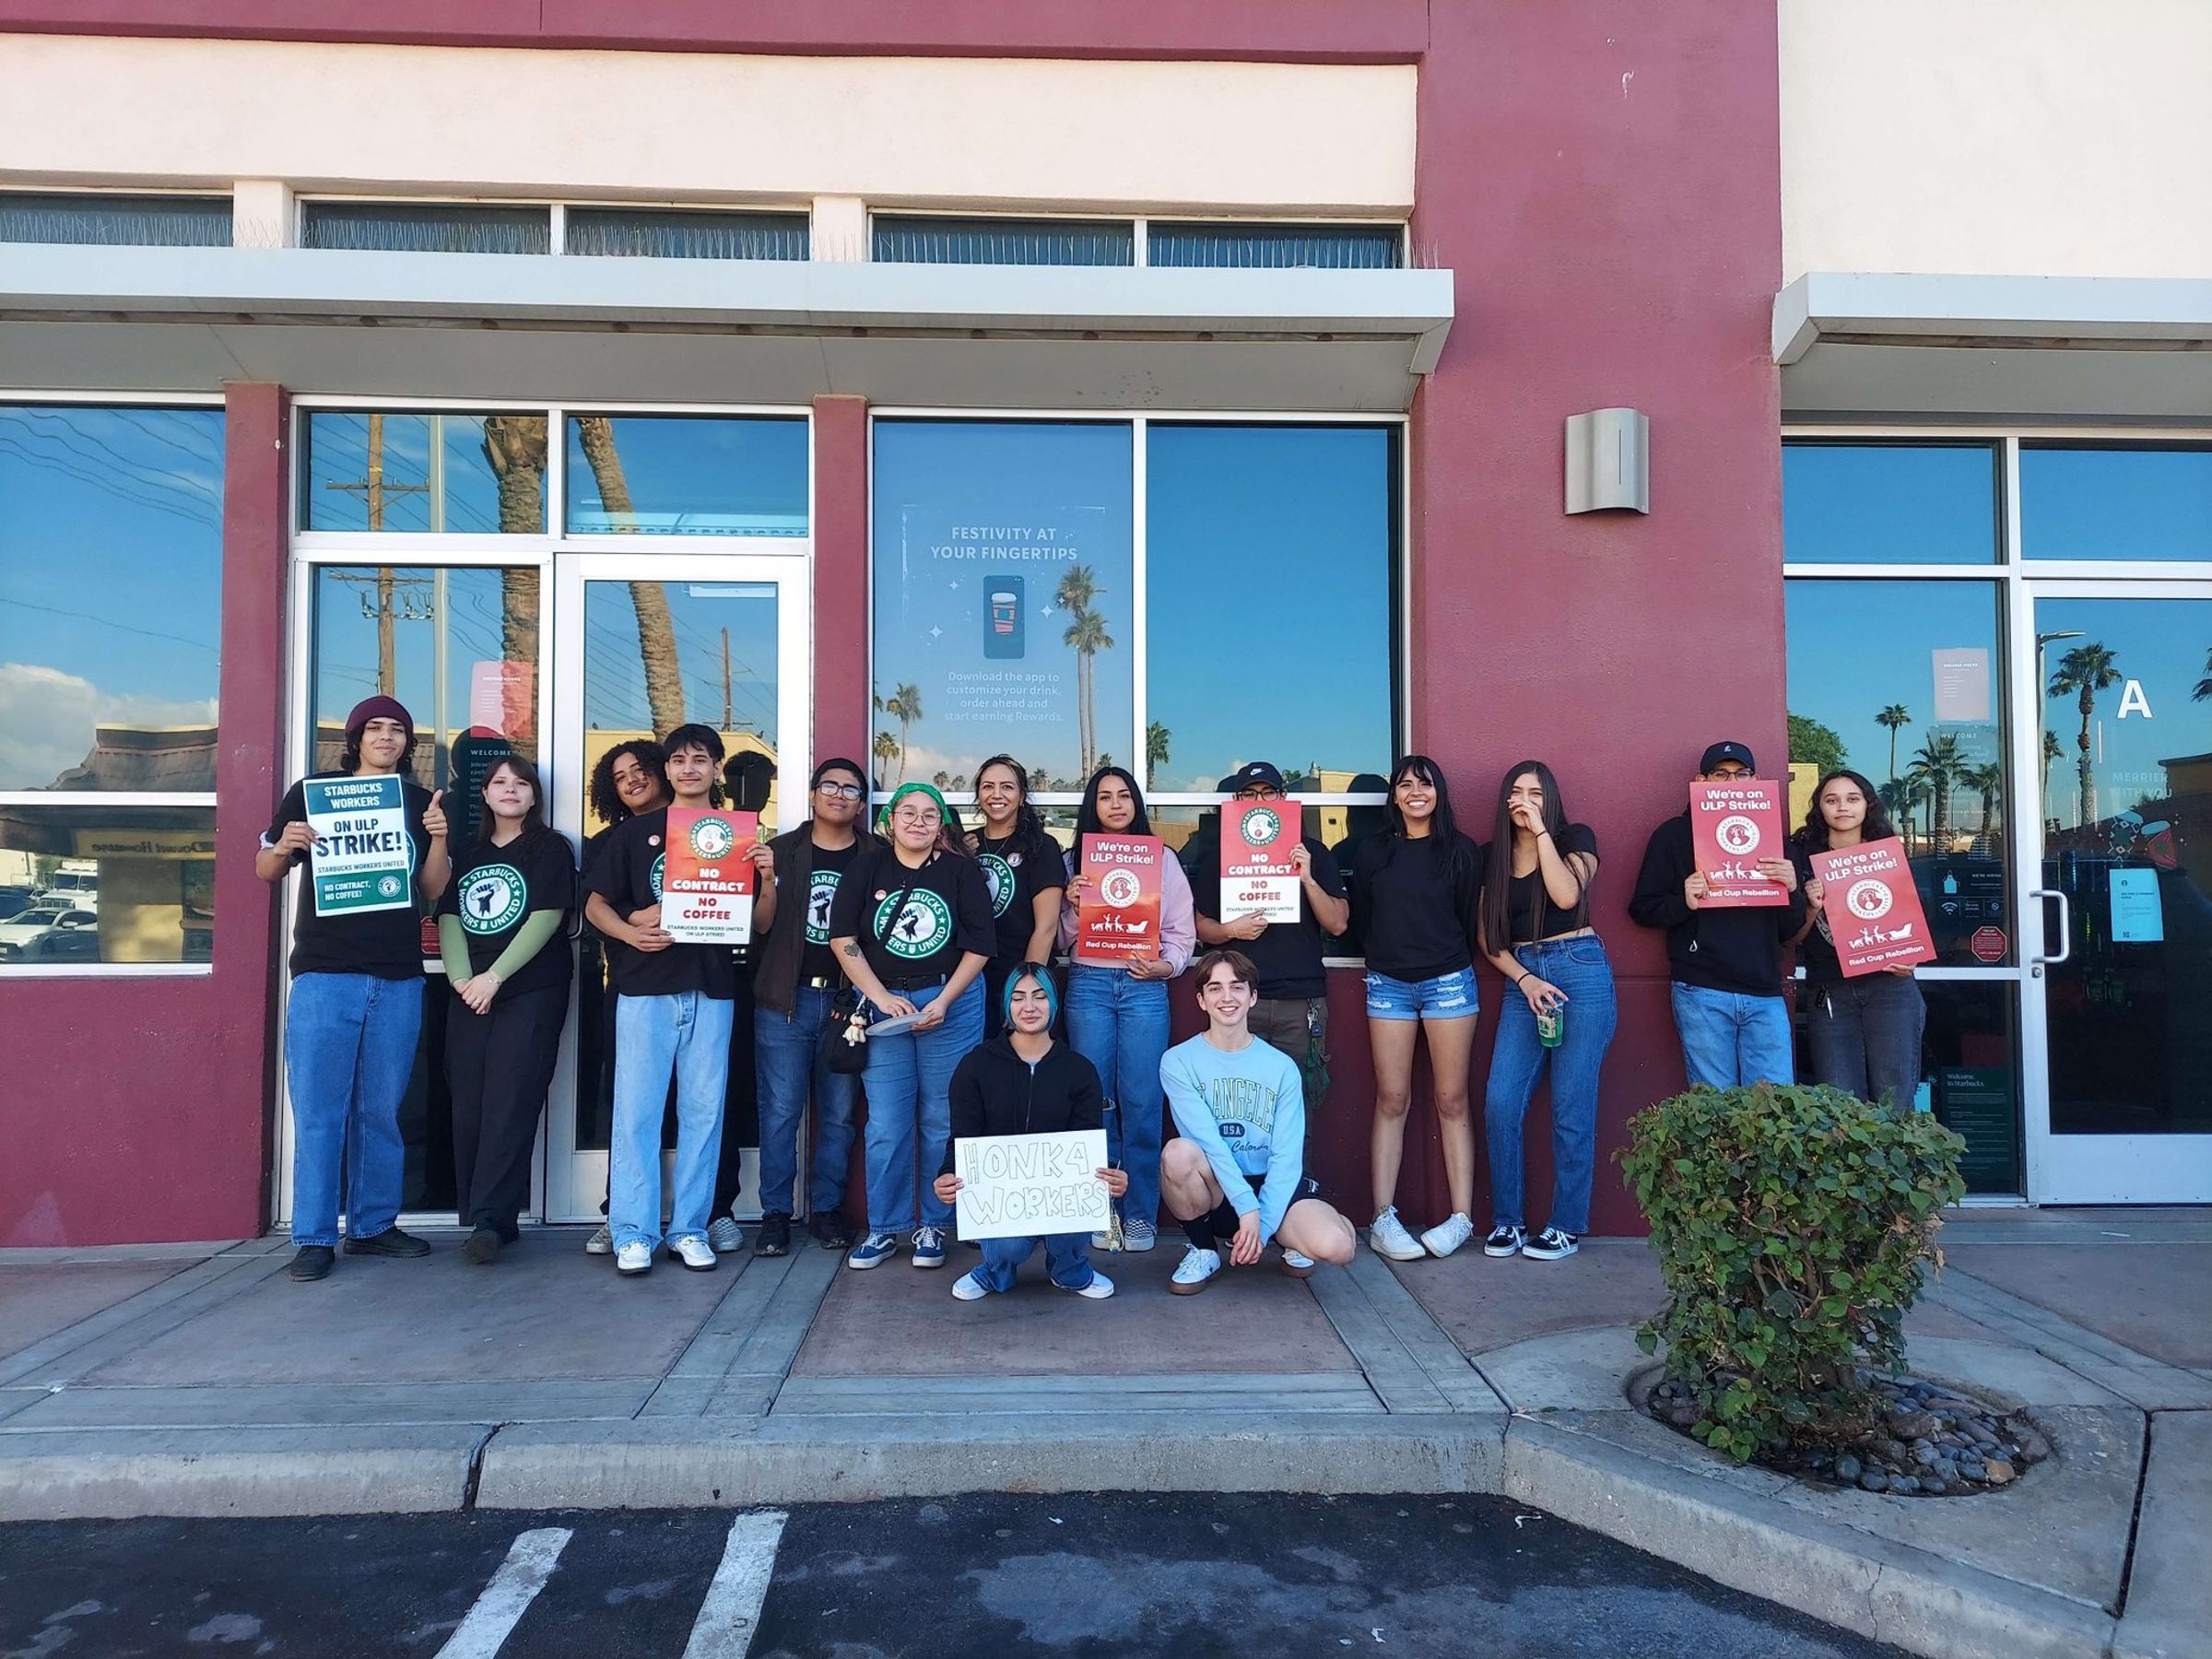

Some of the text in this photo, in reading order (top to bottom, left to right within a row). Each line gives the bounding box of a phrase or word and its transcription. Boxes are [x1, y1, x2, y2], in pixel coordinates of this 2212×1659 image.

[951, 526, 1057, 541] FESTIVITY AT
[930, 546, 1078, 560] YOUR FINGERTIPS
[948, 671, 1061, 684] Download the app to
[947, 684, 1002, 694] customize
[1003, 686, 1028, 697] your
[959, 698, 1049, 709] order ahead and
[2117, 679, 2153, 719] A
[945, 712, 970, 722] start
[971, 712, 1014, 724] earning
[2112, 771, 2169, 782] MERRIER
[324, 782, 383, 797] STARBUCKS
[1706, 790, 1764, 799] We're on
[2147, 787, 2174, 798] YOU
[330, 795, 381, 809] WORKERS
[1700, 800, 1771, 811] ULP Strike!
[334, 818, 379, 833] ON ULP
[693, 818, 731, 832] STARBUCKS
[315, 831, 402, 857] STRIKE!
[1097, 841, 1148, 853] We're on
[1090, 853, 1154, 865] ULP Strike!
[1251, 853, 1269, 863] NO
[1828, 849, 1888, 869] We're on
[317, 859, 405, 874] STARBUCKS WORKERS UNITED
[699, 867, 721, 878] NO
[1228, 865, 1292, 876] CONTRACT
[1824, 859, 1899, 882] ULP Strike!
[469, 867, 521, 888] STARBUCKS
[324, 881, 371, 892] NO CONTRACT,
[672, 879, 746, 892] CONTRACT
[1251, 880, 1268, 889] NO
[324, 890, 362, 901] NO COFFEE!
[1239, 891, 1281, 901] COFFEE
[1724, 889, 1742, 898] Cup
[1742, 888, 1780, 897] Rebellion
[698, 897, 718, 907] NO
[993, 887, 1009, 913] NITED
[489, 899, 521, 929] UNITED
[683, 910, 732, 920] COFFEE
[917, 926, 947, 952] UNITED
[1100, 942, 1117, 950] Cup
[1117, 942, 1151, 950] Rebellion
[1848, 945, 1924, 967] Red Cup Rebellion
[963, 1142, 1064, 1185] HONK
[960, 1180, 1108, 1226] WORKERS
